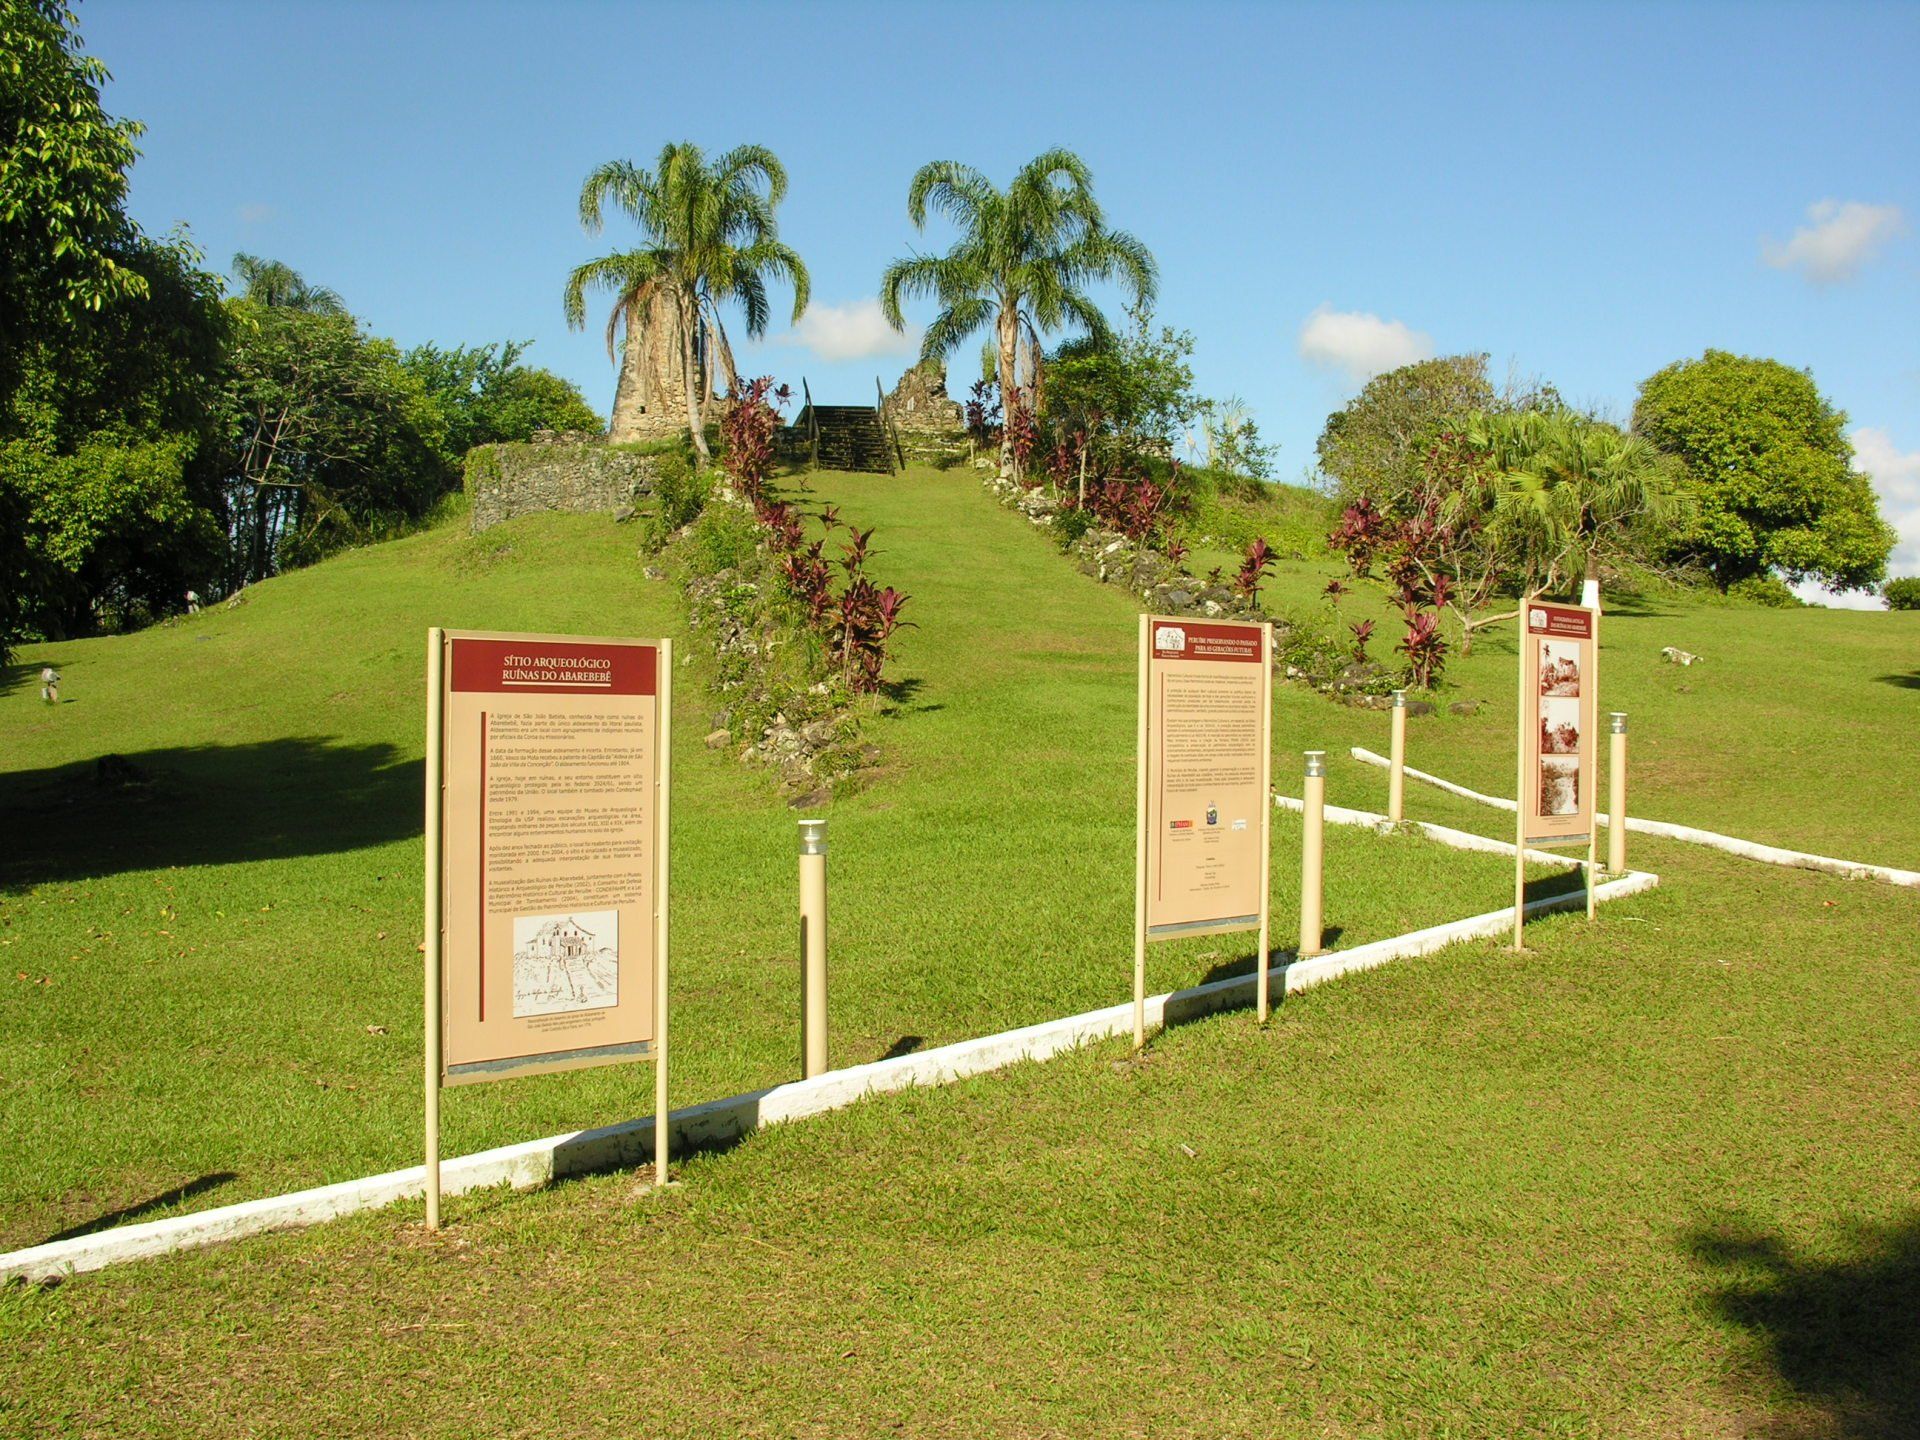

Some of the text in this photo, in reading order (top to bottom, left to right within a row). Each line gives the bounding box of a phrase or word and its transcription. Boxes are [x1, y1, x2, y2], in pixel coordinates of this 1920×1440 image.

[504, 654, 610, 669] SÍTIO ARQUEOLÓGICO
[502, 668, 611, 681] RUÍNAS DO ABAREBEBÊ
